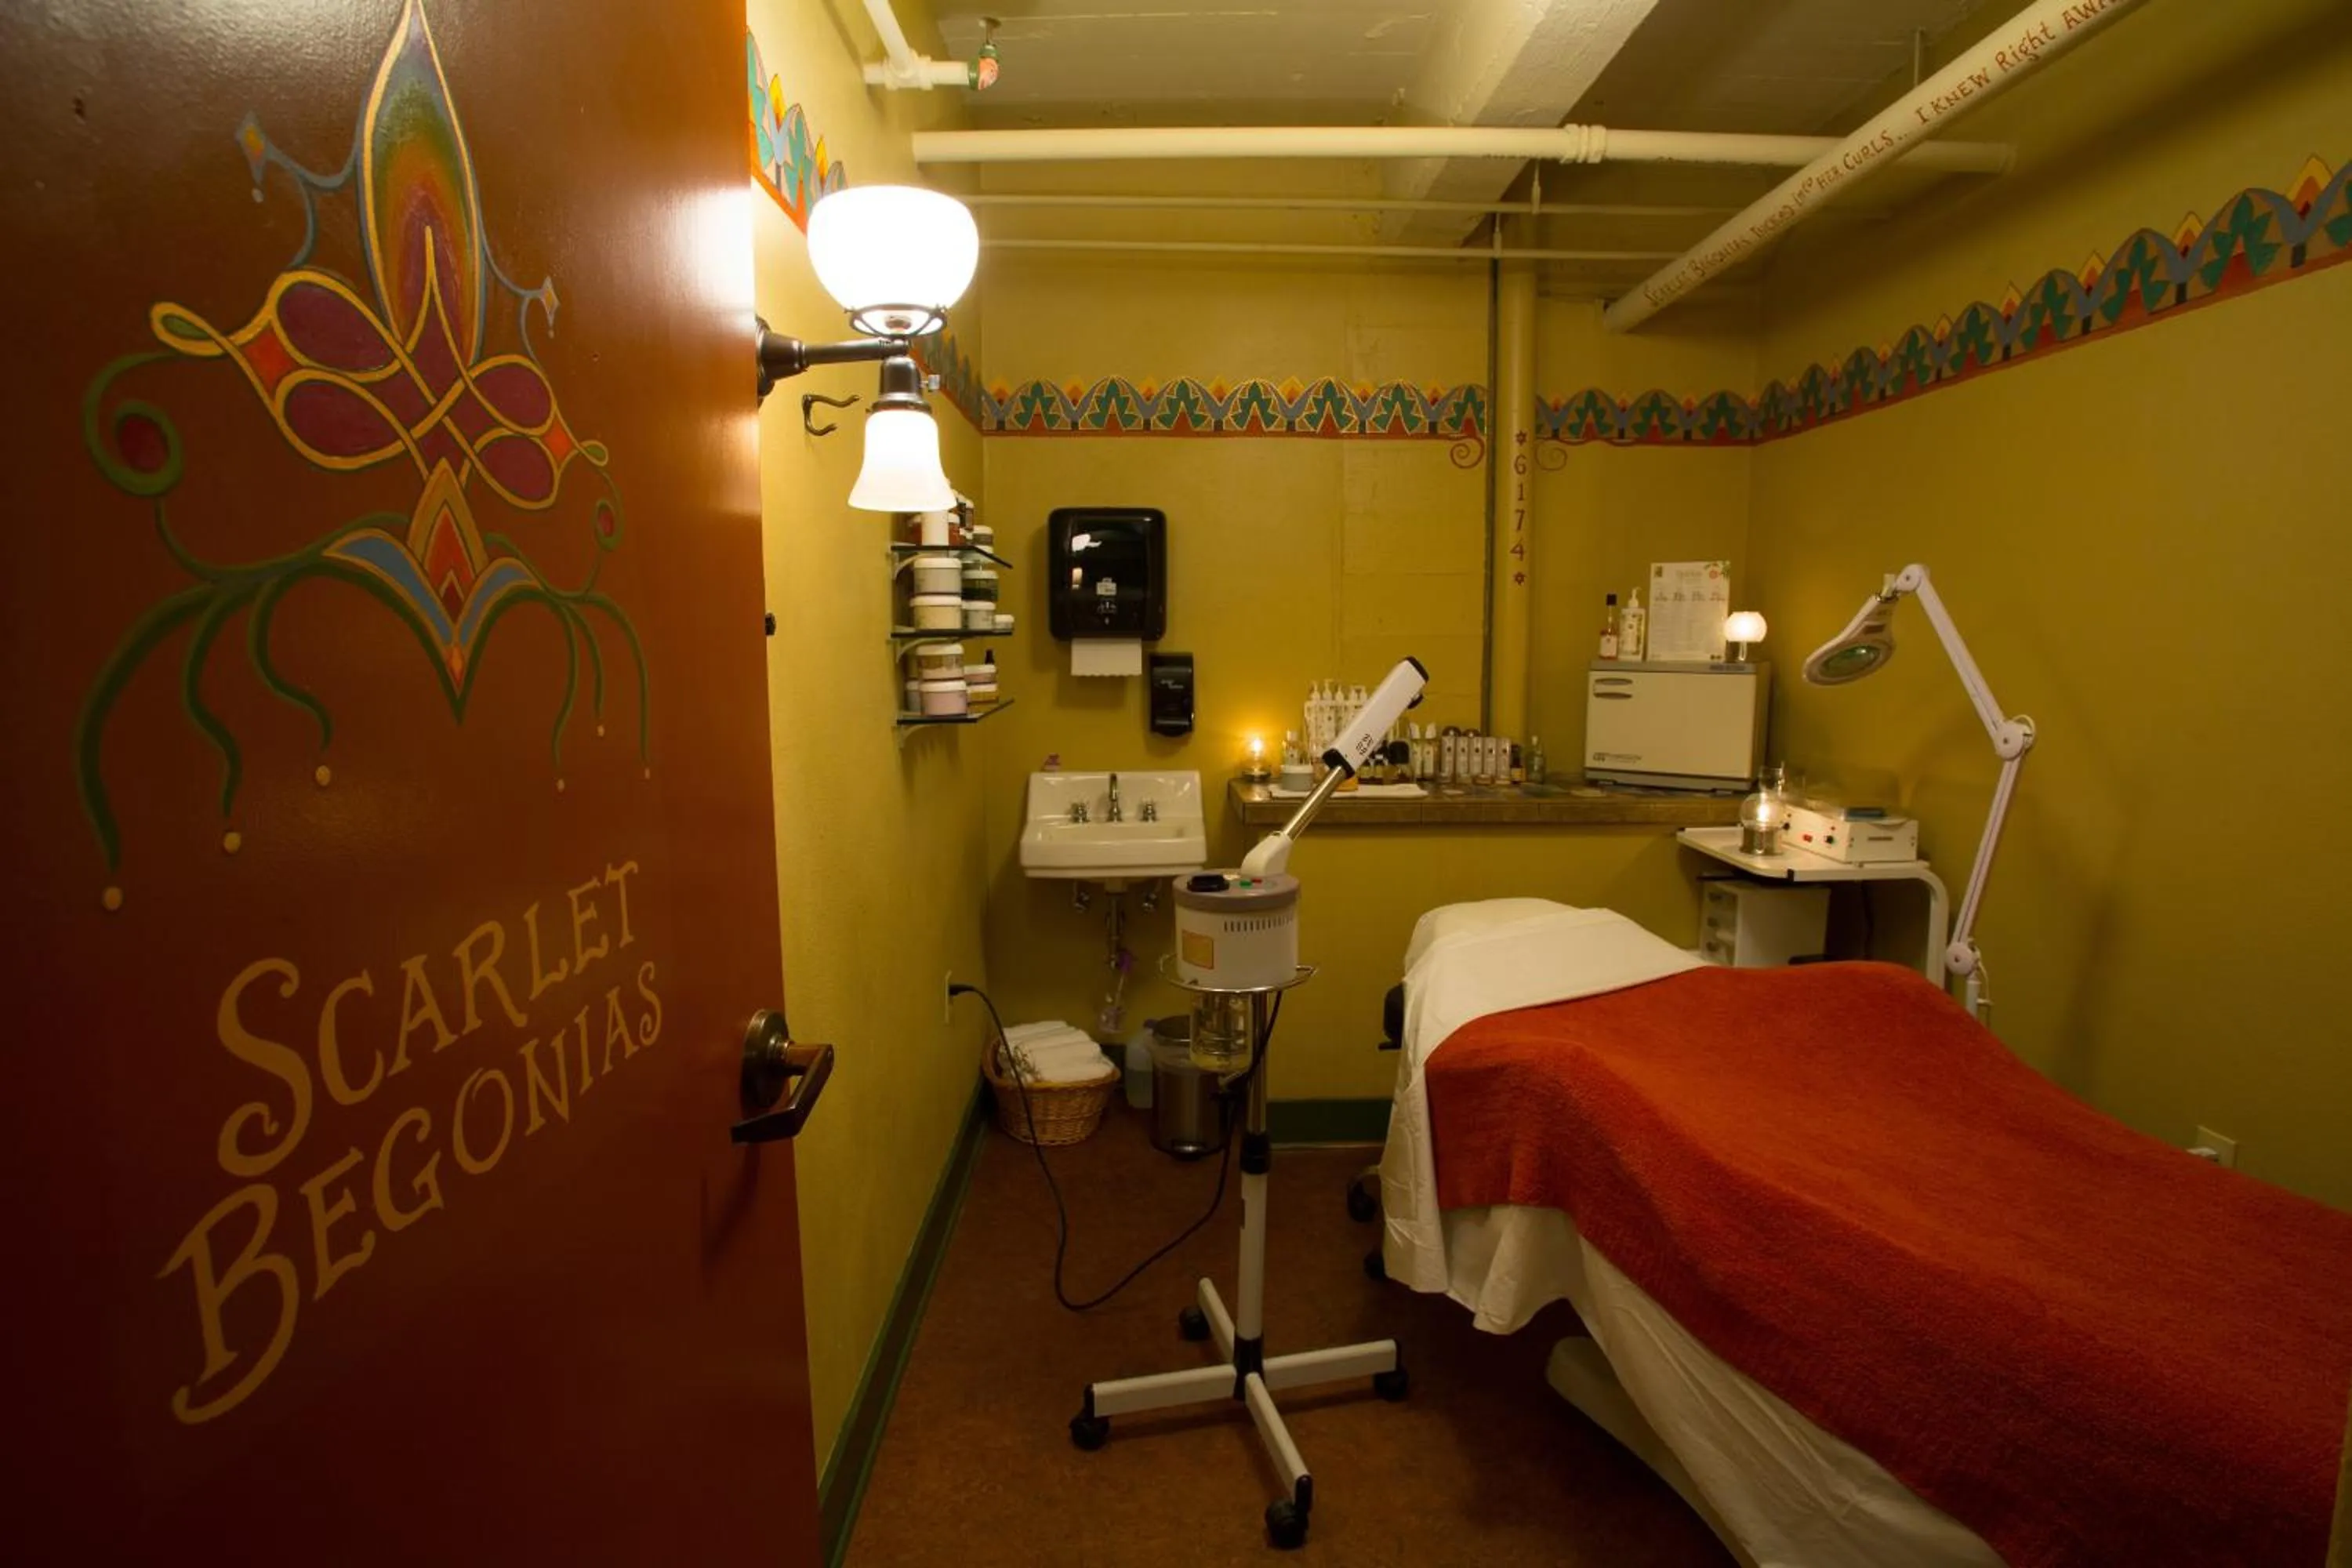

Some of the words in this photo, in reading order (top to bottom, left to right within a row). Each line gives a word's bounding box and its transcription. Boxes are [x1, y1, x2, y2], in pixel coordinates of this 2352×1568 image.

[1915, 107, 1929, 124] I
[1931, 67, 1991, 115] KNEW
[217, 861, 638, 1176] SCARLET
[156, 961, 662, 1424] BEGONIAS
